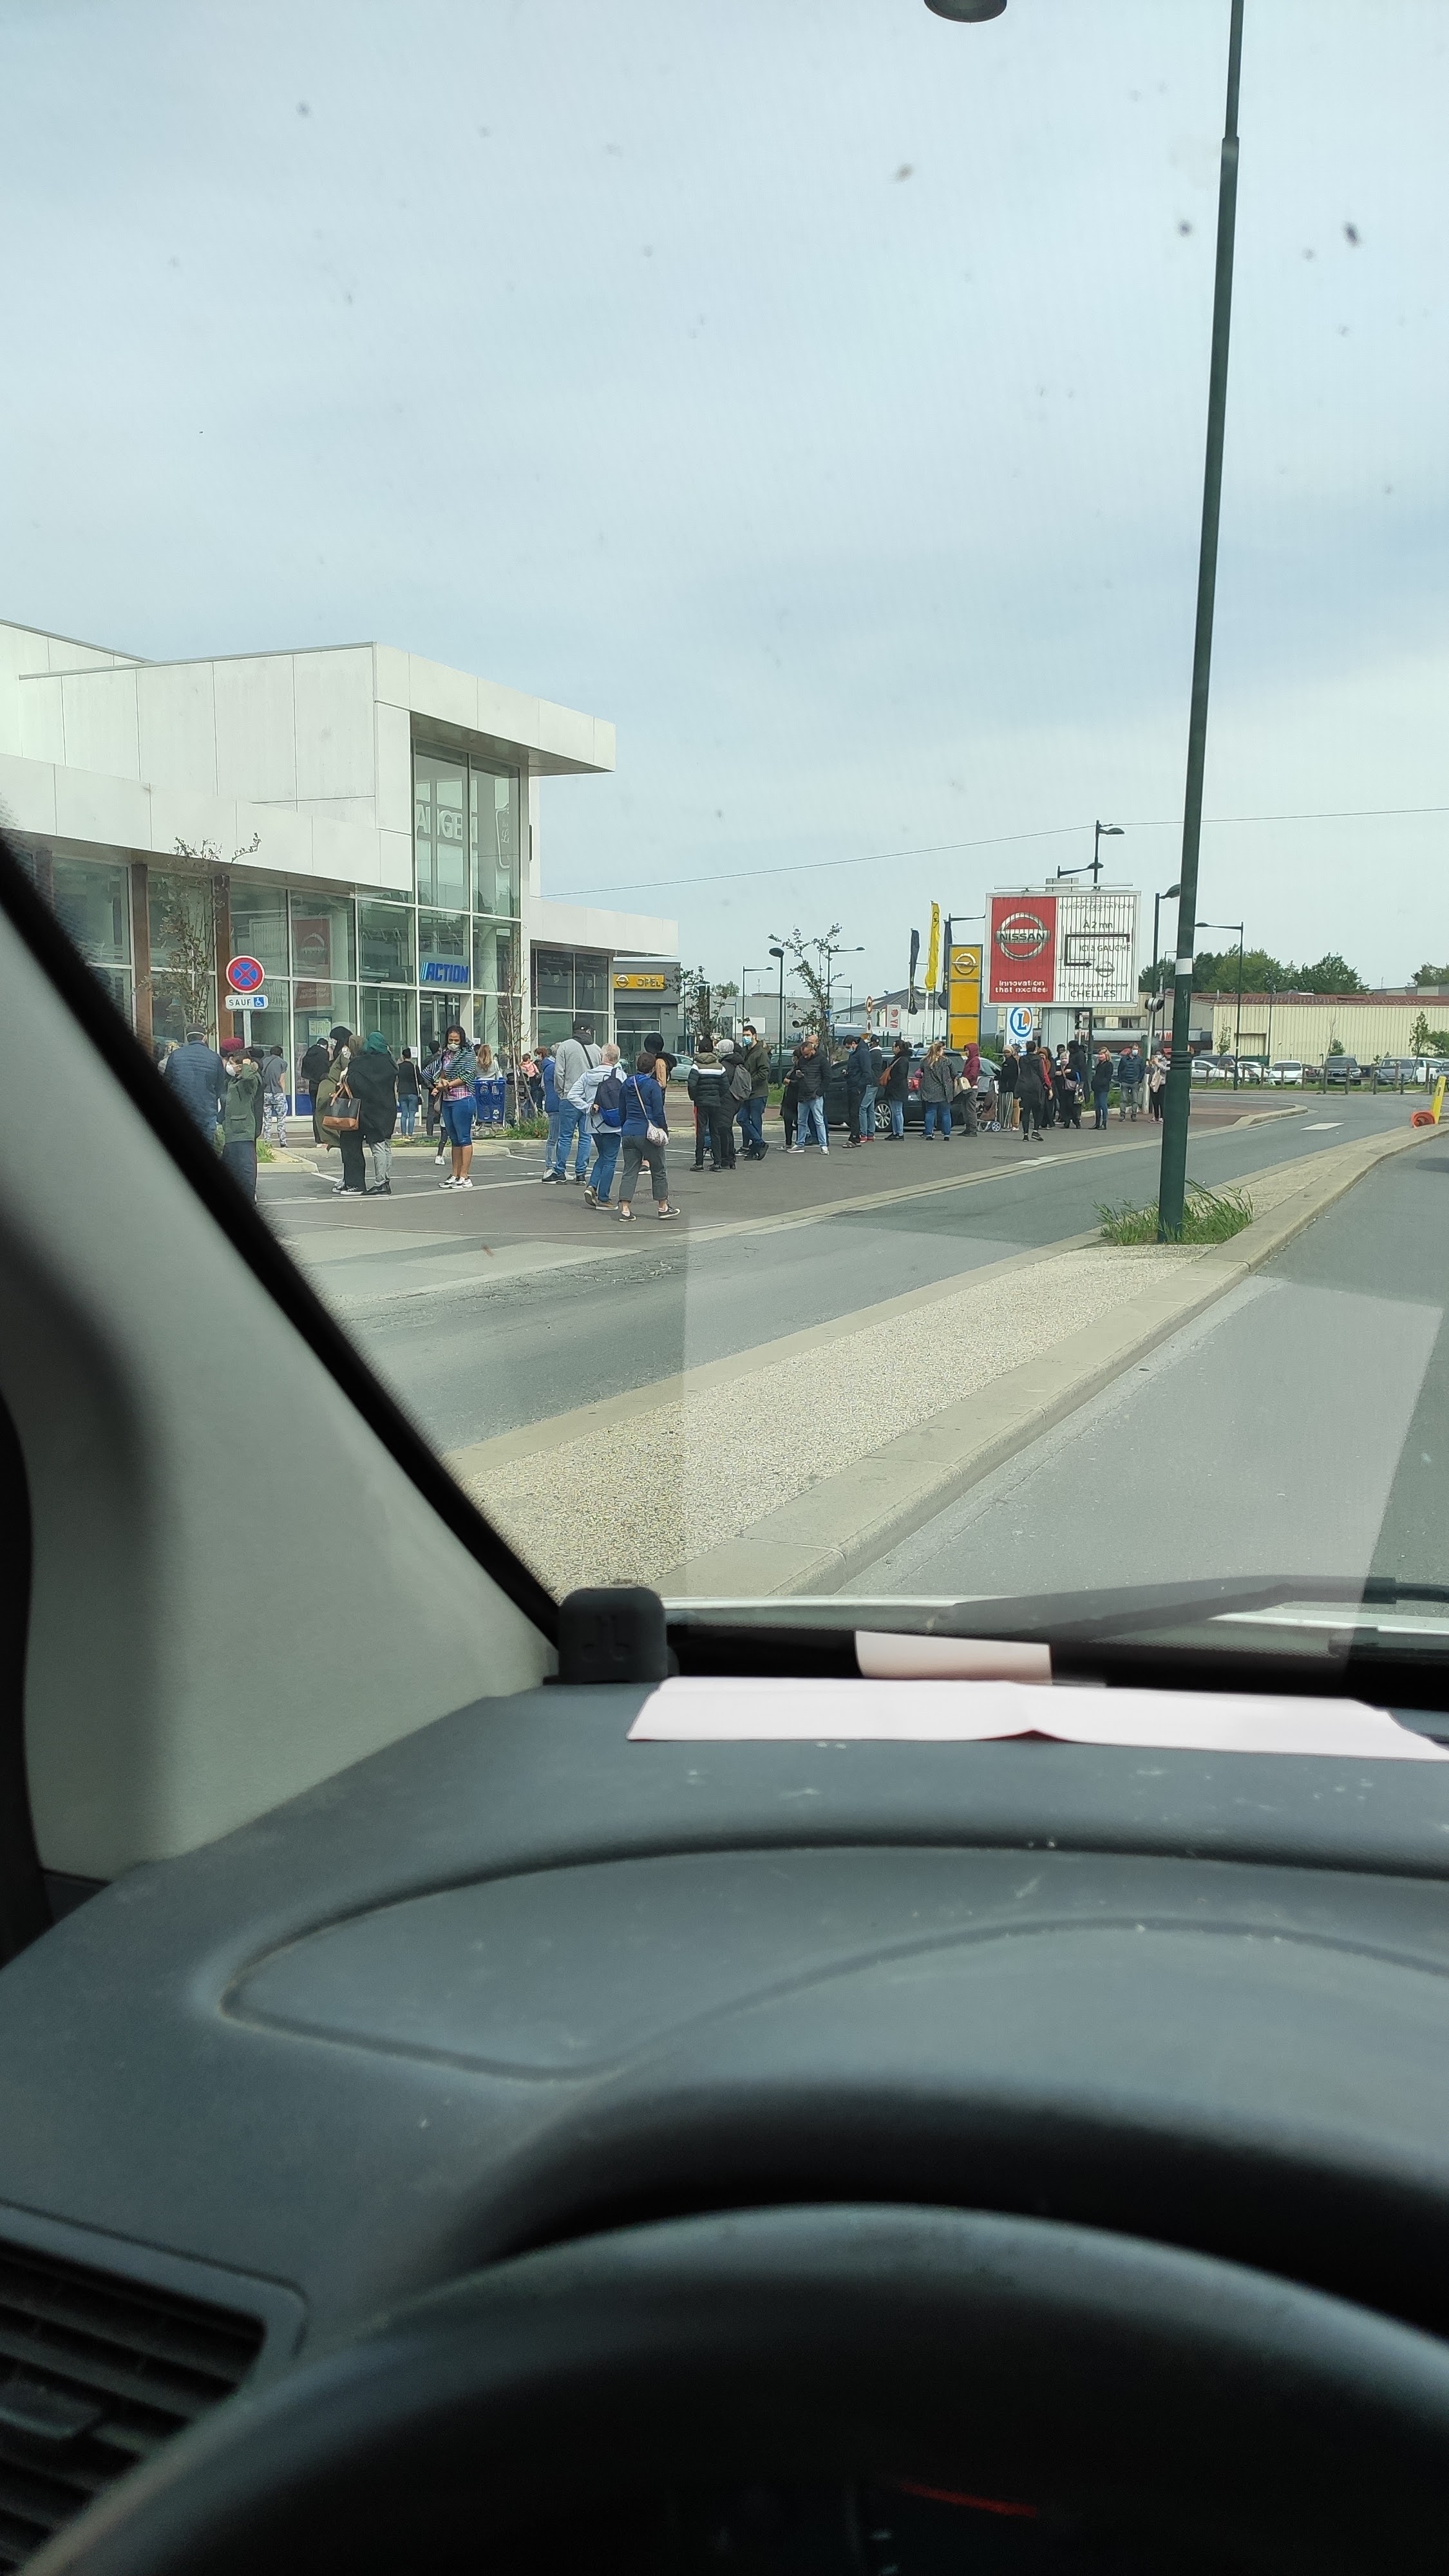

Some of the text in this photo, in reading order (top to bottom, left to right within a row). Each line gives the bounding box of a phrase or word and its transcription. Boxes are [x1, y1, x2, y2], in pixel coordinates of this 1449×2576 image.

[999, 933, 1045, 941] NISSAN
[426, 962, 469, 983] ACTION
[636, 976, 661, 987] OPEL
